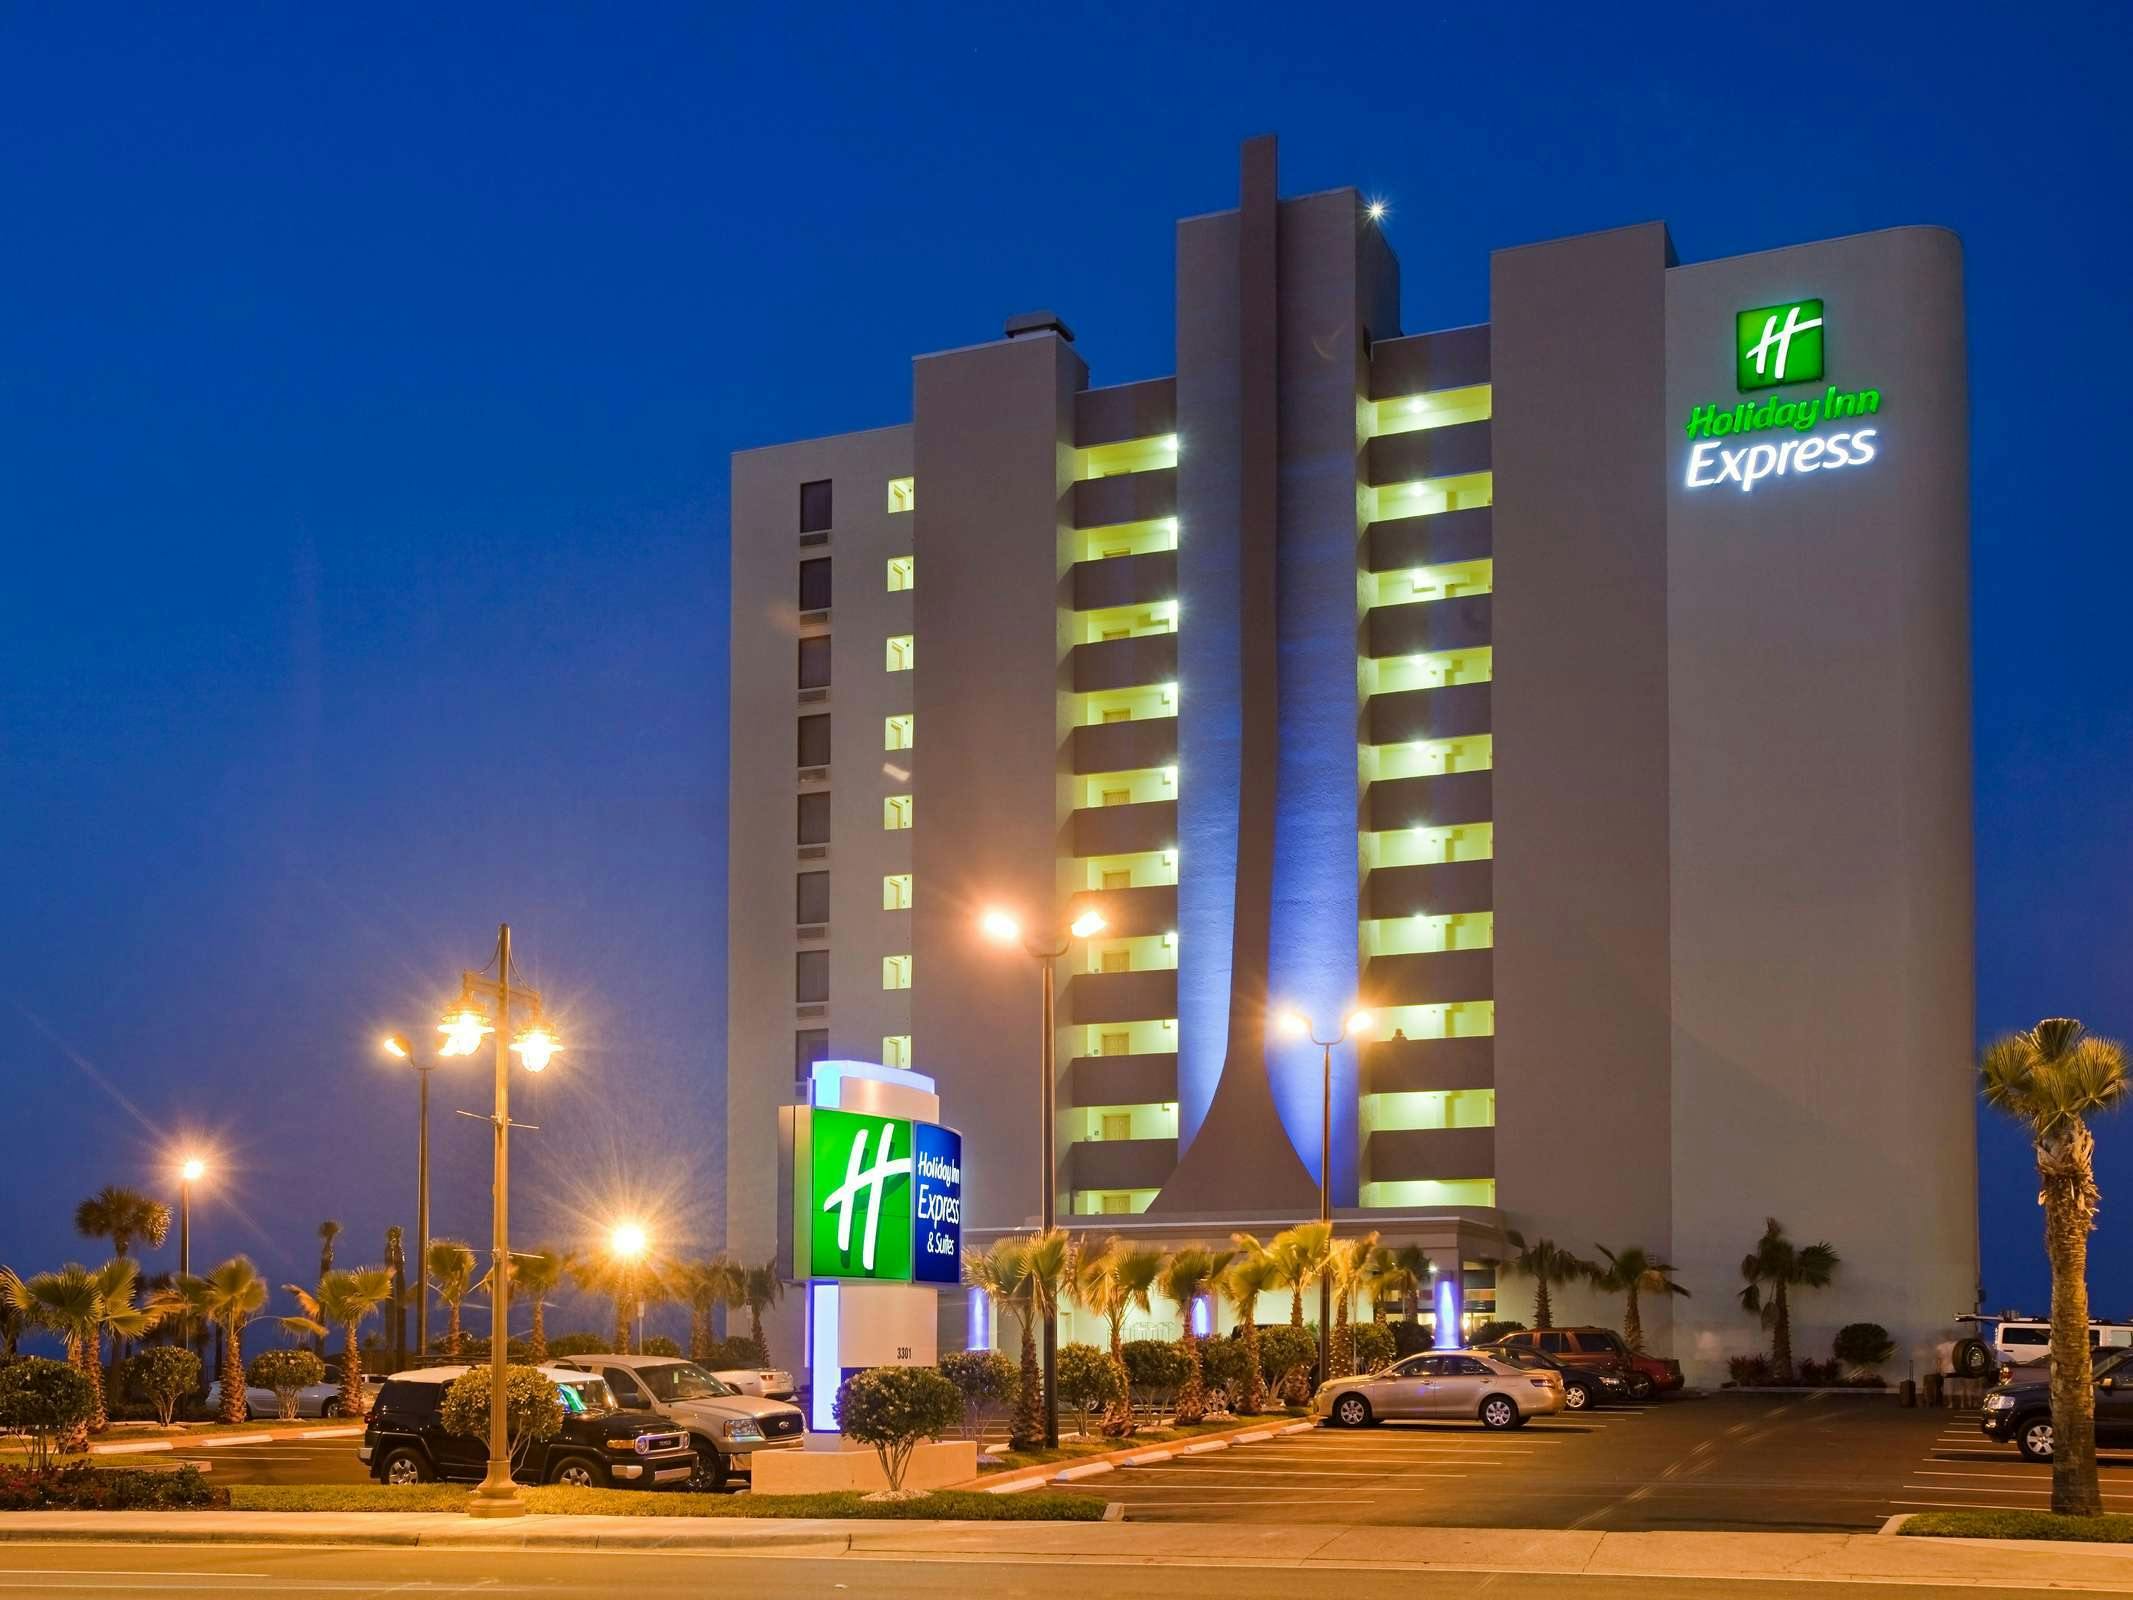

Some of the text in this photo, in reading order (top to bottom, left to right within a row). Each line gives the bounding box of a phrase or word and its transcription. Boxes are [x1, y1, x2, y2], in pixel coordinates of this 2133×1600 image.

[1746, 306, 1823, 379] H
[1685, 385, 1881, 440] Holiday Inn
[1686, 429, 1876, 492] Express
[918, 1151, 960, 1187] Holiday Inn
[824, 1122, 911, 1271] H
[918, 1183, 960, 1230] Express
[927, 1231, 954, 1255] & Suites
[897, 1346, 912, 1359] 3301
